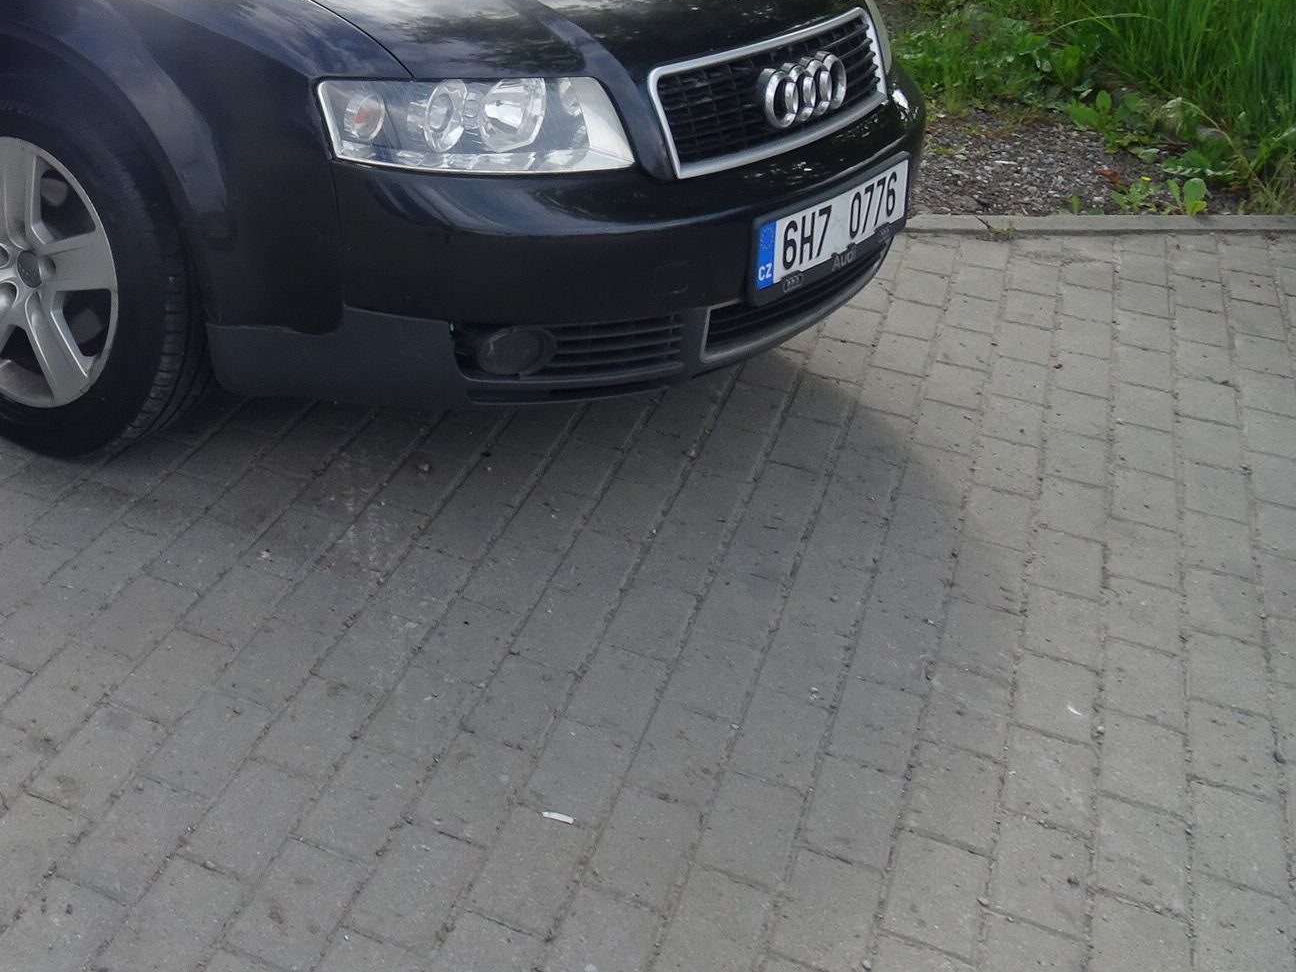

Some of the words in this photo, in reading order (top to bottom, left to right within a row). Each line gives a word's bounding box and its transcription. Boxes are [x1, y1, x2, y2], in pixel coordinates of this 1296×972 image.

[781, 204, 833, 271] 6H7
[849, 170, 898, 240] 0776
[757, 262, 773, 282] CZ
